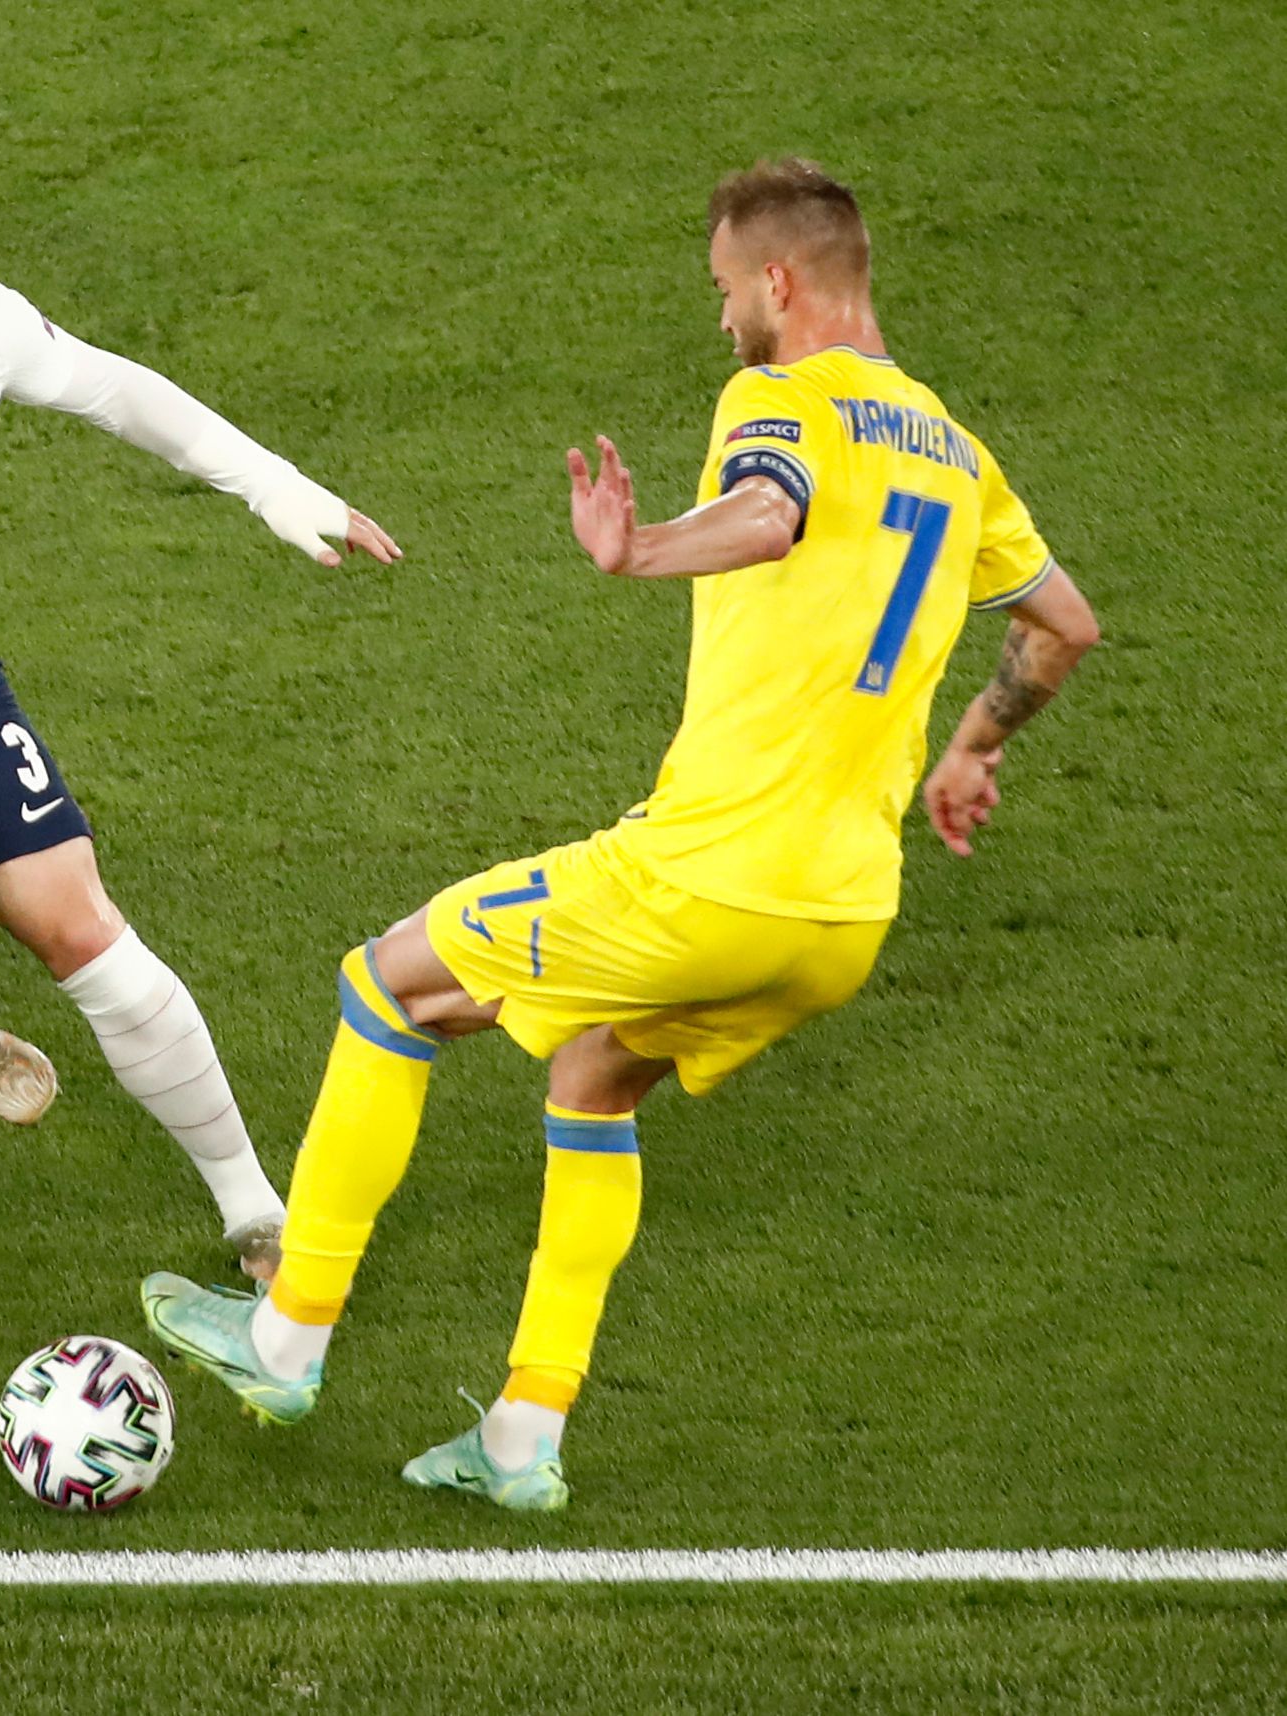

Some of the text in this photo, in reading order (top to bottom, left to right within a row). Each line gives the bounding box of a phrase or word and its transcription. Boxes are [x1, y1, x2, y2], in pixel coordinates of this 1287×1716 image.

[741, 423, 799, 437] RESPECT
[829, 397, 979, 480] YARMOLEN
[852, 486, 953, 696] 7
[0, 721, 50, 793] 3
[477, 868, 551, 911] 7
